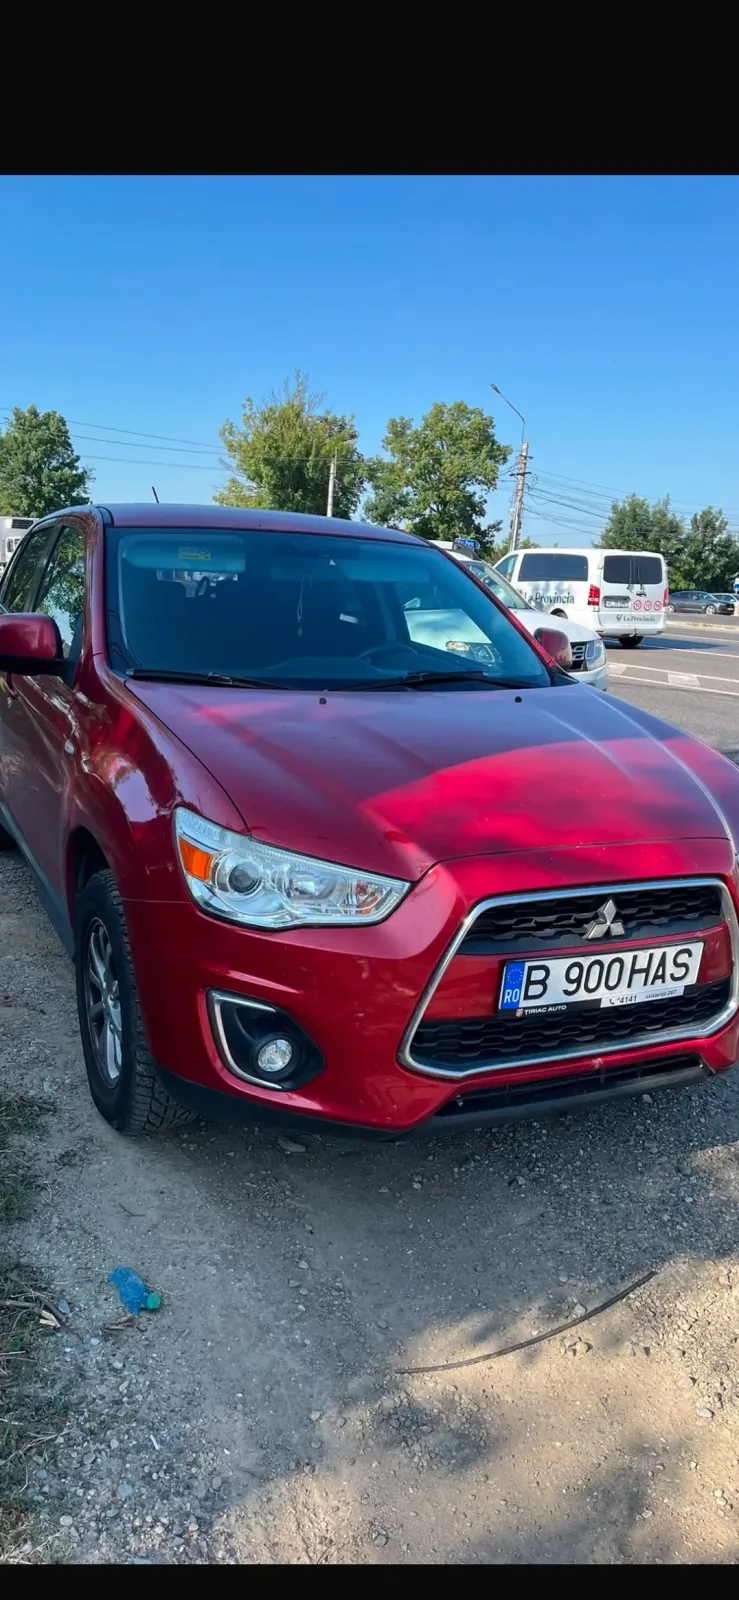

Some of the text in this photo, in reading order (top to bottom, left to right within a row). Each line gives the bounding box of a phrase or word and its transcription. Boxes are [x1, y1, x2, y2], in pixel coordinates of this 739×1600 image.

[535, 592, 575, 604] Provincia
[523, 948, 693, 1000] B 900 HAS
[503, 988, 520, 1004] RO
[524, 1007, 548, 1015] TIRIAC
